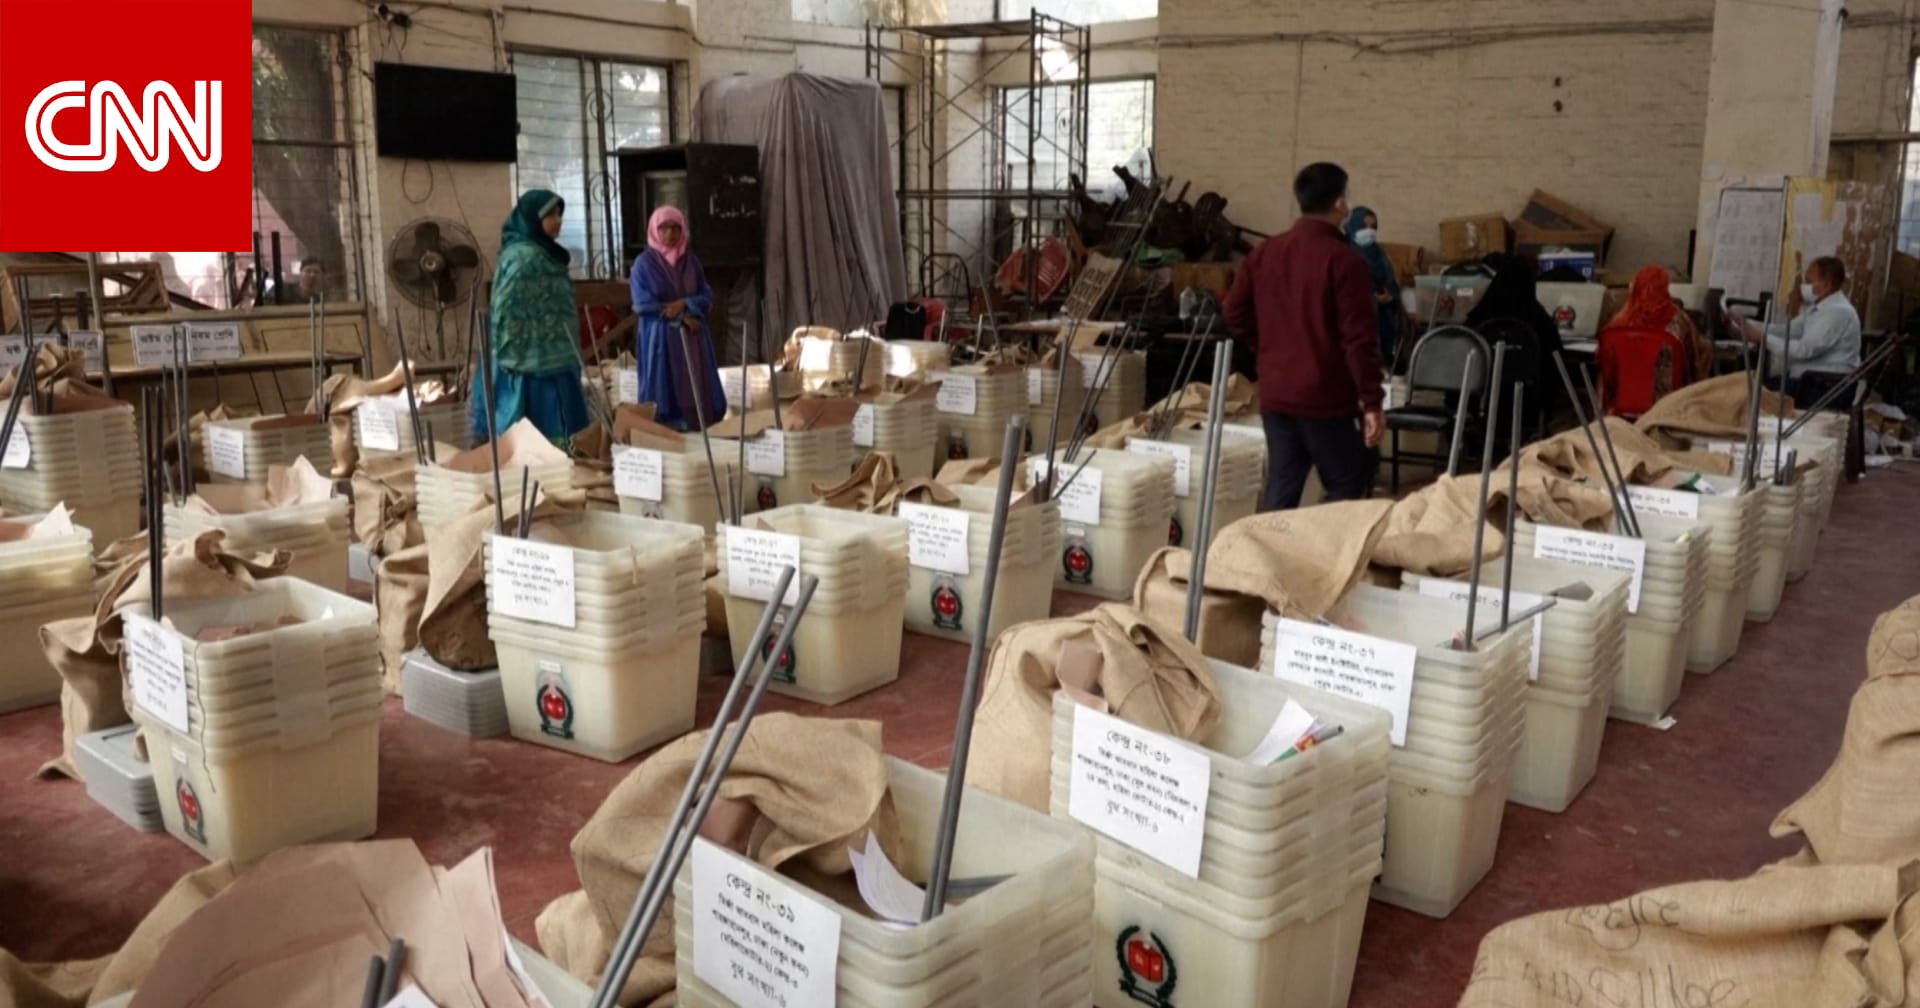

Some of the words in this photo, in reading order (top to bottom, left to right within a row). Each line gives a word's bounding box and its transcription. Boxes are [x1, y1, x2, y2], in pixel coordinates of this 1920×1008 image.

[1106, 730, 1131, 750] কেন্দ্র
[1134, 739, 1171, 765] নং-৩৮
[726, 873, 752, 899] কেন্দ্র
[756, 888, 795, 923] নং-৩৯
